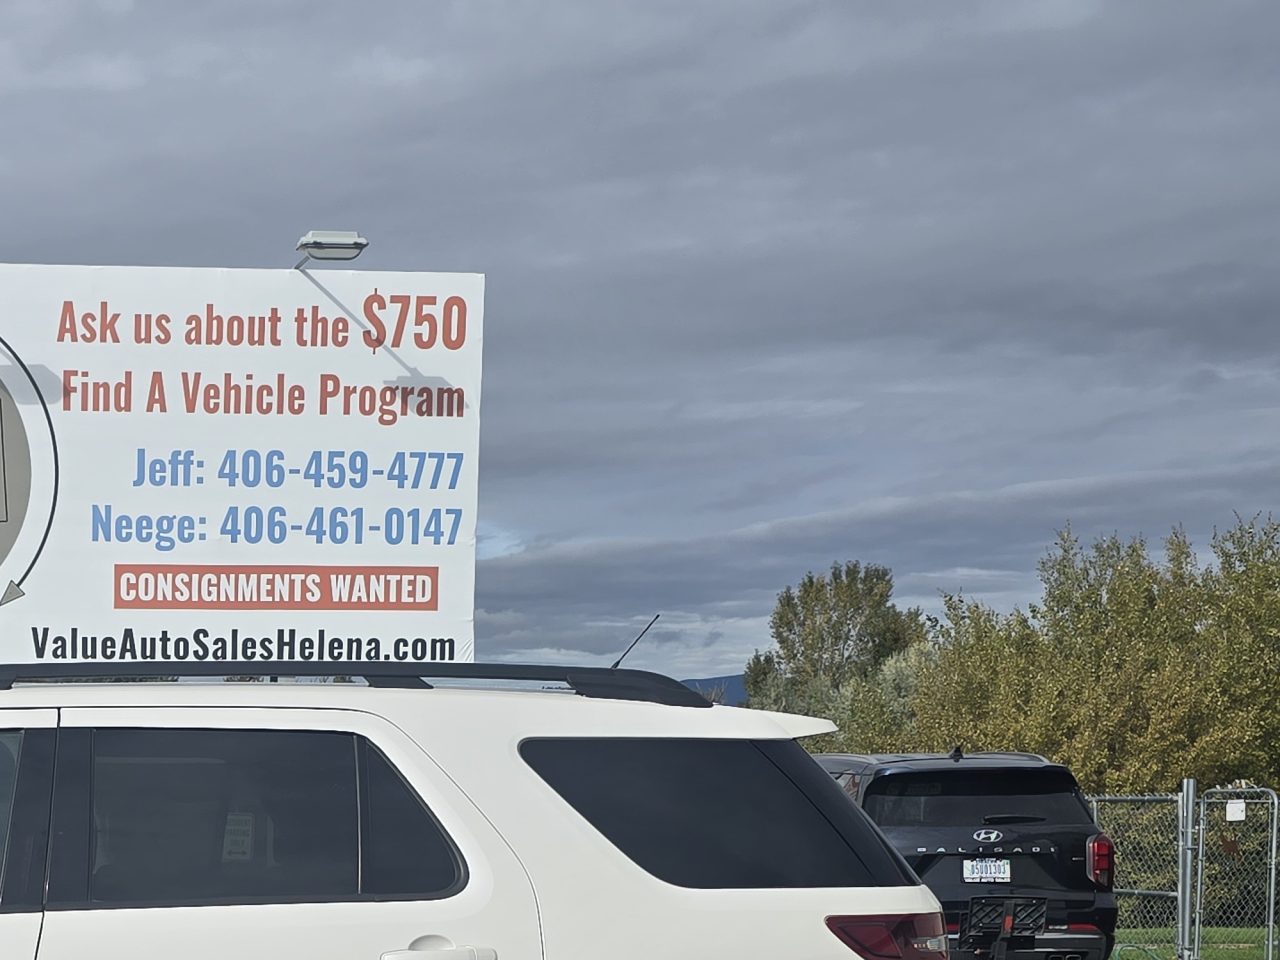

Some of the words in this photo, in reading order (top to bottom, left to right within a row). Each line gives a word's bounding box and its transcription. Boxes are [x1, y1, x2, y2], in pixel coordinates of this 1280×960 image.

[57, 301, 120, 343] Ask
[133, 314, 171, 345] us
[184, 304, 281, 347] about
[295, 306, 349, 348] the
[362, 288, 468, 355] $750
[62, 370, 132, 413] Find
[145, 372, 167, 413] A
[181, 372, 306, 416] Vehicle
[319, 374, 465, 426] Program
[132, 448, 205, 487] Jeff:
[217, 449, 465, 490] 406-459-4777
[91, 504, 207, 552] Neege:
[219, 505, 463, 546] 406-461-0147
[119, 572, 322, 603] CONSIGNMENTS
[329, 574, 433, 604] WANTED
[31, 626, 456, 662] ValueAutoSalesHelena.com
